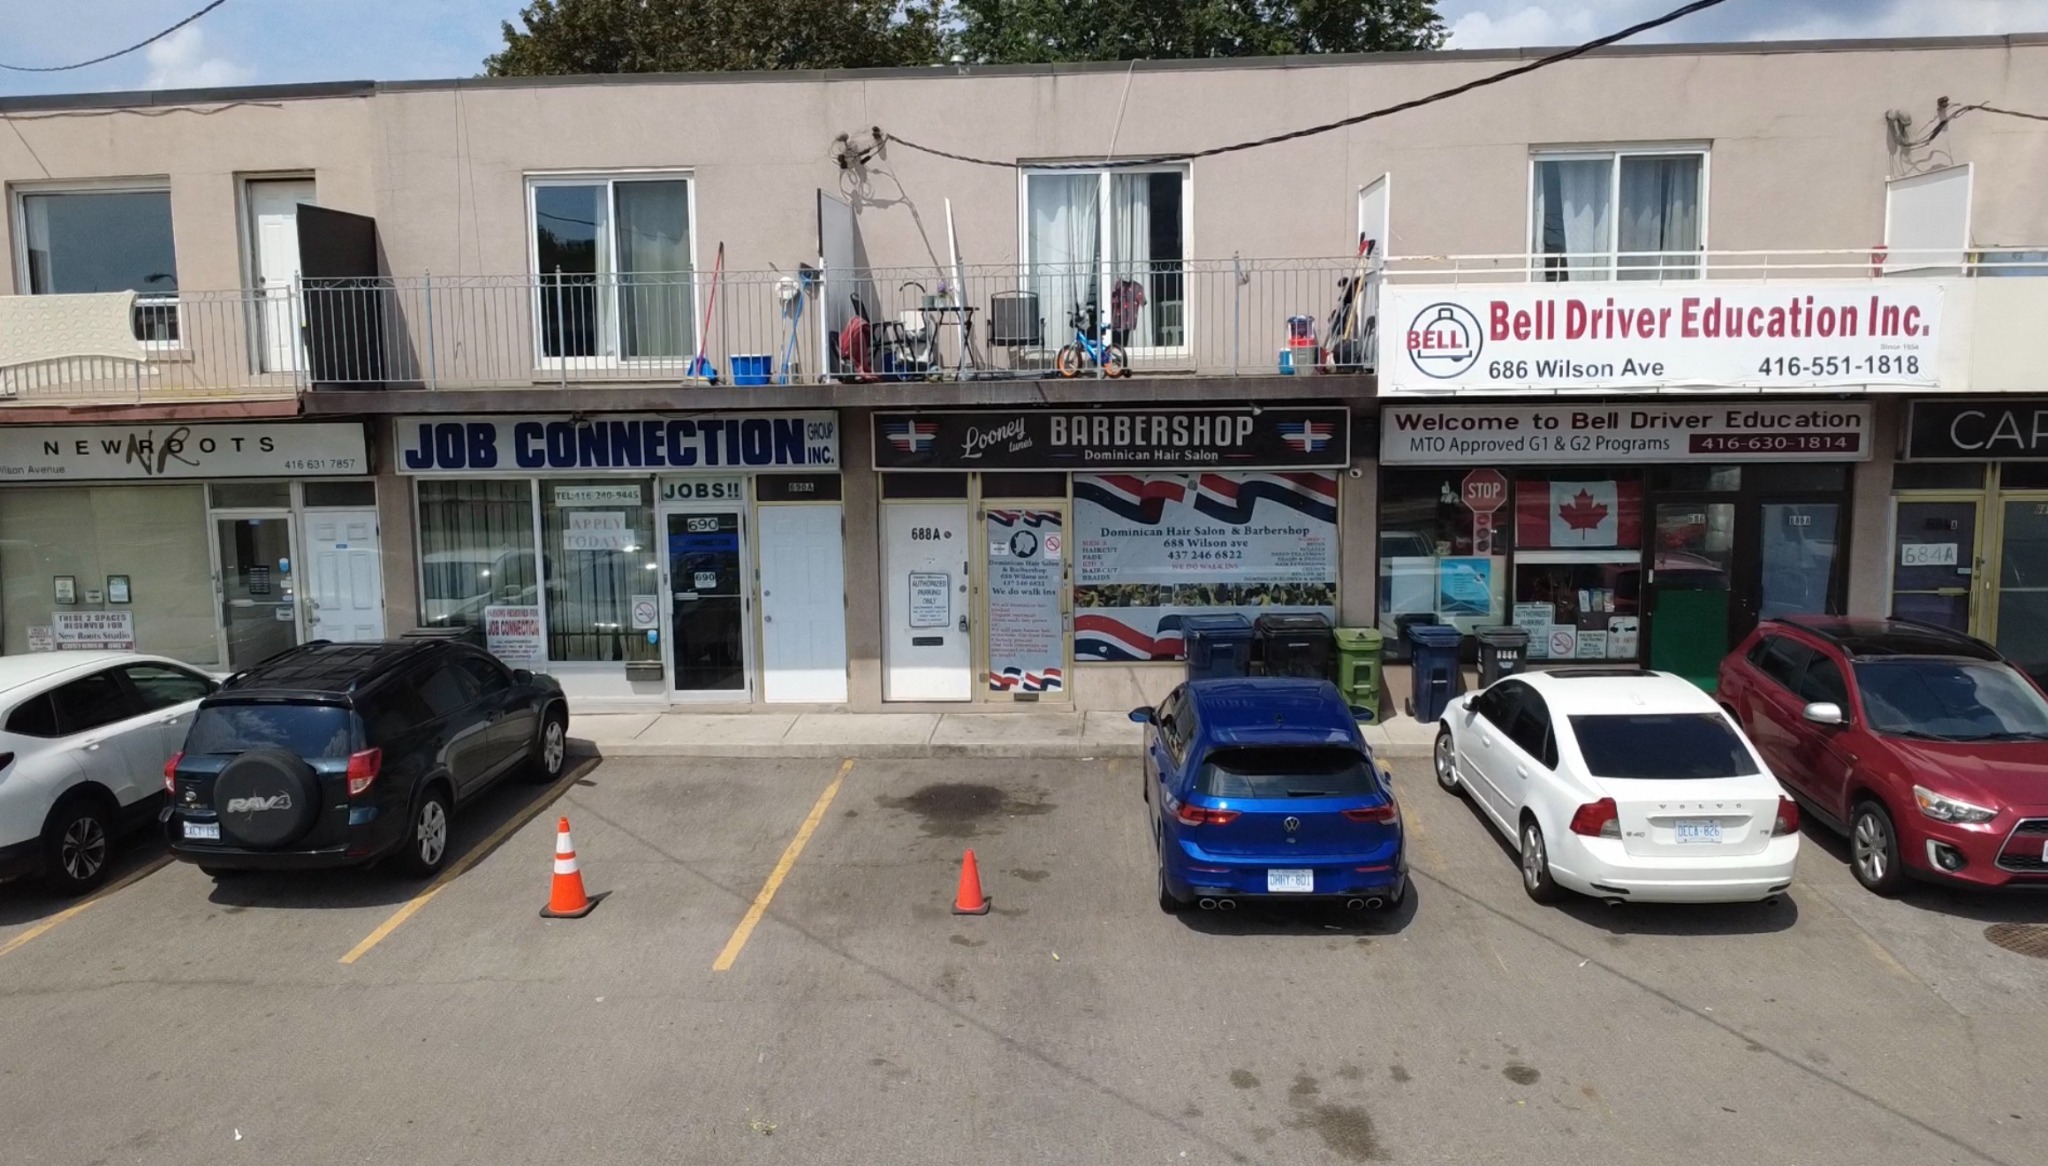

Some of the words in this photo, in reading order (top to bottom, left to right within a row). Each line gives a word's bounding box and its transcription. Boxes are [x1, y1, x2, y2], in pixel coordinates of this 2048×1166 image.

[1489, 299, 1554, 341] Bell
[1565, 297, 1672, 340] Driver
[1681, 295, 1858, 338] Education
[1868, 295, 1930, 337] Inc.
[1406, 330, 1462, 350] BELL
[1489, 360, 1528, 379] 686
[1536, 358, 1614, 378] Wilson
[1620, 357, 1664, 377] Ave
[1758, 355, 1919, 376] 416-551-1818
[1395, 413, 1519, 431] Welcome
[1533, 413, 1559, 429] to
[1571, 412, 1618, 429] Bell
[1630, 411, 1713, 429] Driver
[1726, 410, 1861, 428] Education
[806, 421, 833, 440] GROUP
[960, 417, 1026, 459] Looney
[1050, 415, 1254, 446] BARBERSHOP
[43, 440, 122, 455] NEW
[138, 436, 275, 454] ROOTS
[405, 422, 498, 469] JOB
[514, 418, 805, 468] CONNECTION
[1008, 437, 1033, 453] tunes
[1410, 437, 1445, 452] MTO
[1450, 436, 1524, 455] Approved
[1529, 436, 1548, 451] G1
[1554, 436, 1565, 451] &
[1570, 436, 1590, 451] G2
[1596, 435, 1670, 455] Programs
[1701, 436, 1847, 450] 416-630-1814
[807, 446, 834, 465] INC.
[1084, 449, 1150, 460] Dominican
[1154, 449, 1179, 460] Hair
[1184, 449, 1219, 460] Salon
[0, 464, 24, 475] ilson
[28, 465, 65, 475] Avenue
[284, 460, 304, 470] 416
[306, 460, 325, 469] 631
[329, 459, 355, 469] 7857
[664, 483, 739, 499] JOBS!!
[1468, 482, 1501, 499] STOP
[572, 519, 621, 530] APPLY
[688, 519, 718, 531] 690
[1101, 527, 1163, 537] Dominican
[1166, 527, 1191, 536] Hair
[1194, 526, 1226, 536] Salon
[1231, 526, 1240, 535] &
[1244, 525, 1310, 536] Barbershop
[911, 528, 941, 541] 688A
[1163, 539, 1184, 548] 688
[1187, 538, 1227, 547] Wilson
[1168, 551, 1188, 560] 437
[1192, 551, 1212, 559] 246
[1215, 550, 1243, 559] 6822
[1904, 546, 1954, 563] 684A
[695, 573, 715, 581] 690
[992, 587, 1006, 595] We
[58, 632, 76, 640] New
[103, 631, 130, 639] Studio
[488, 620, 500, 636] JOB
[501, 620, 539, 637] CONNECTION
[227, 795, 292, 813] RAV4
